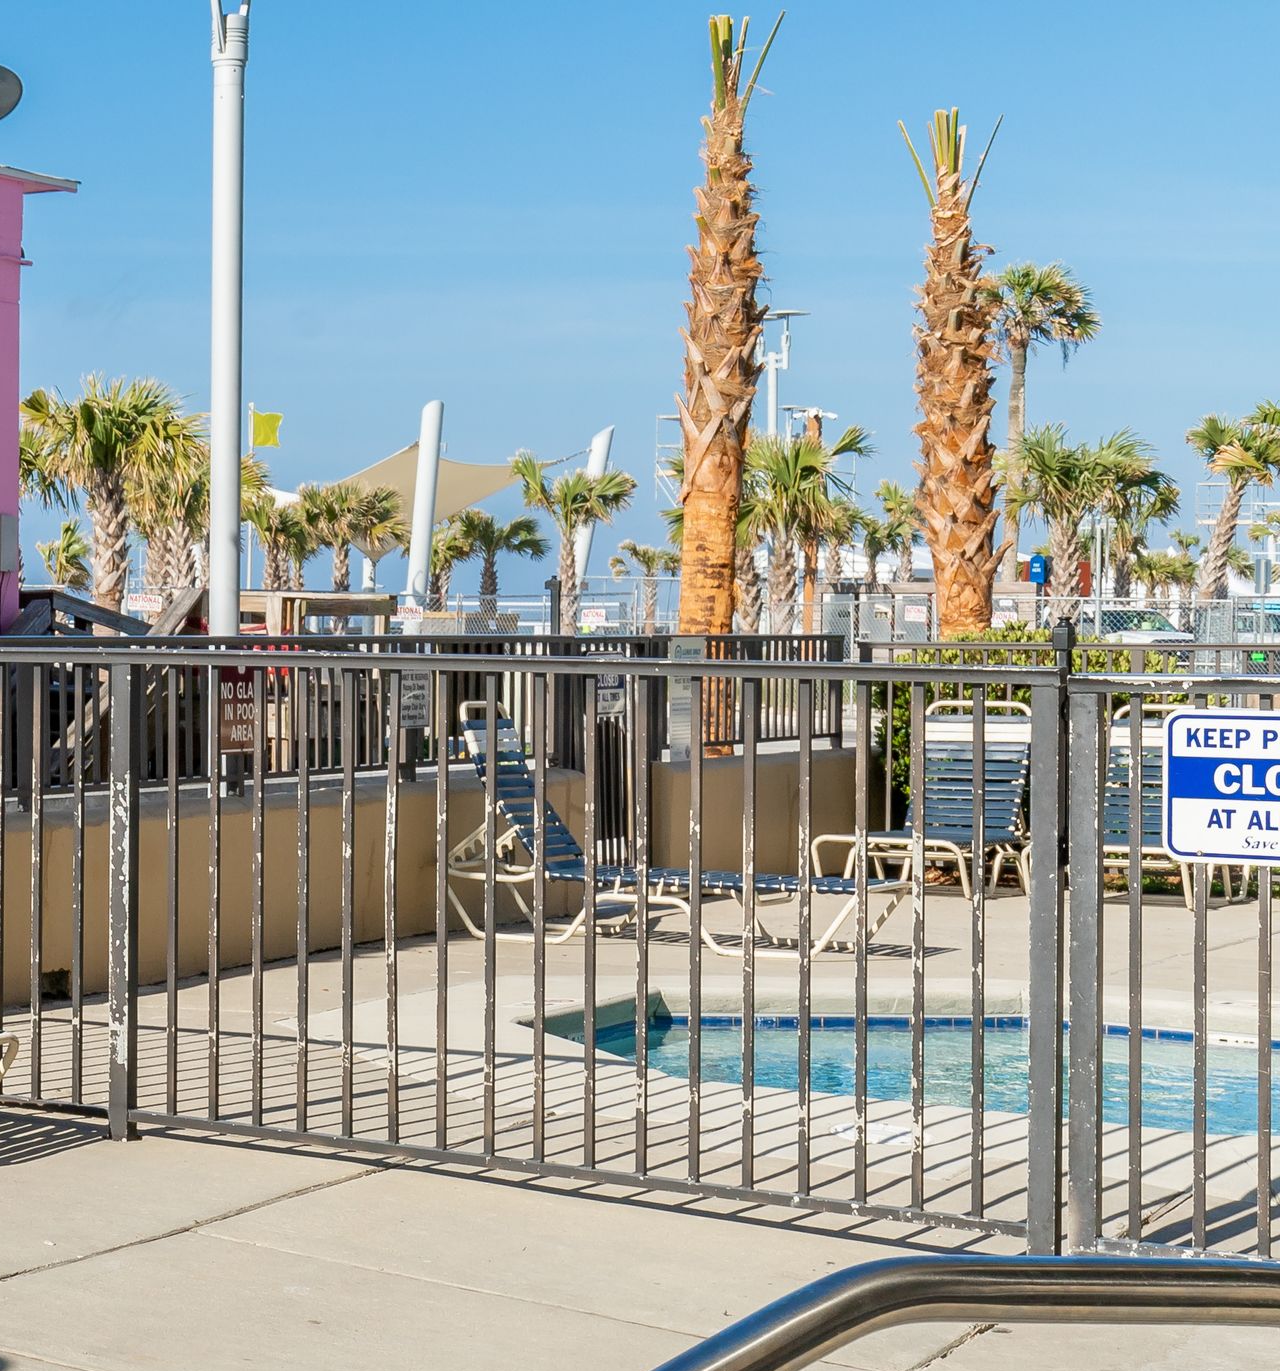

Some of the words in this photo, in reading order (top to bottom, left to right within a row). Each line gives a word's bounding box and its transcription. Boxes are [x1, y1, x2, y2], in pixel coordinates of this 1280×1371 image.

[397, 606, 422, 614] ATIONAL
[221, 682, 234, 699] NO
[236, 681, 254, 699] GLA
[224, 703, 234, 720] IN
[236, 703, 254, 720] POO
[230, 724, 254, 742] AREA
[1186, 728, 1251, 749] KEEP
[1262, 729, 1279, 750] P
[1207, 808, 1236, 829] AT
[1247, 810, 1279, 831] AL
[1242, 836, 1279, 850] Save
